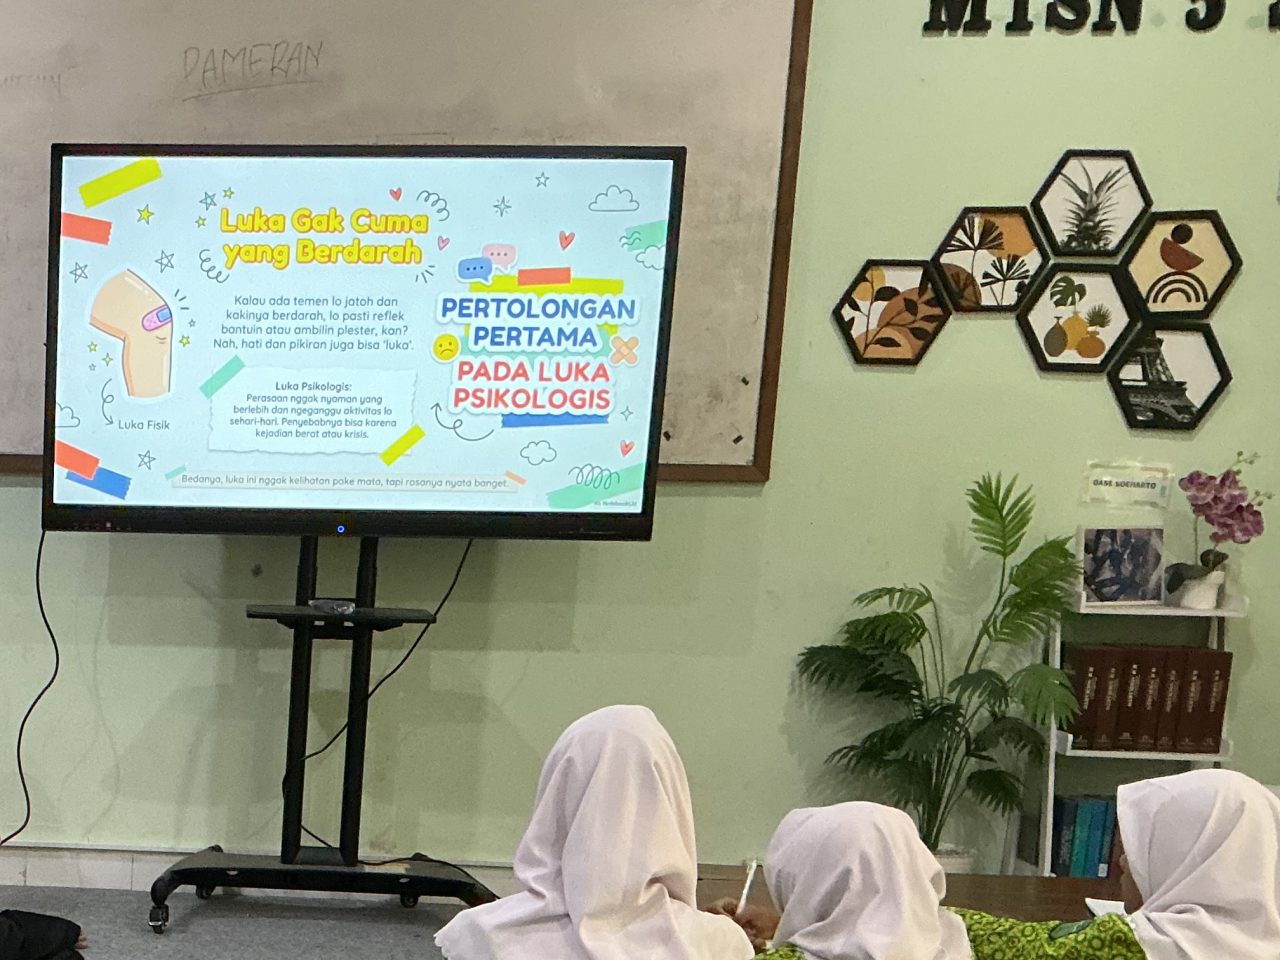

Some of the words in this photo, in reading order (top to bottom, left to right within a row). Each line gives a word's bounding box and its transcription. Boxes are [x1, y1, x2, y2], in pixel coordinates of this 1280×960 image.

[220, 207, 286, 233] Luka
[291, 207, 345, 233] Gak
[350, 208, 429, 233] Cuma
[223, 243, 290, 270] yang
[295, 238, 422, 264] Berdarah
[234, 296, 266, 306] Kalau
[269, 296, 290, 306] ada
[293, 297, 329, 306] temen
[332, 296, 342, 306] lo
[344, 296, 374, 309] jatoh
[377, 297, 398, 306] dan
[441, 298, 635, 319] PERTOLONGAN
[226, 310, 269, 323] kakinya
[272, 310, 326, 322] berdarah,
[329, 311, 340, 321] lo
[343, 311, 369, 323] pasti
[372, 311, 404, 321] reflek
[221, 324, 262, 335] bantuin
[265, 326, 290, 335] atau
[294, 325, 334, 335] ambilin
[338, 325, 378, 337] plester,
[382, 326, 408, 336] kan?
[473, 327, 597, 347] PERTAMA
[214, 339, 238, 350] Nah,
[242, 339, 262, 349] hati
[266, 339, 286, 349] dan
[290, 339, 326, 351] pikiran
[330, 340, 354, 352] juga
[358, 340, 380, 350] bisa
[458, 361, 530, 382] PADA
[538, 362, 610, 383] LUKA
[276, 382, 299, 391] Luka
[302, 382, 352, 393] Psikologis:
[246, 394, 288, 403] Perasaan
[290, 394, 319, 406] nggak
[320, 396, 358, 406] nyaman
[360, 396, 382, 406] yang
[453, 388, 611, 410] PSIKOLOGIS
[233, 406, 269, 414] berlebih
[272, 406, 288, 414] dan
[291, 407, 341, 417] ngeganggu
[344, 406, 382, 416] aktivitas
[384, 406, 392, 415] lo
[118, 420, 144, 430] Luka
[147, 420, 170, 430] Fisik
[230, 417, 279, 426] sehari-hari.
[282, 417, 342, 429] Penyebabnya
[344, 418, 363, 427] bisa
[366, 418, 397, 427] karena
[256, 429, 293, 440] kejadian
[296, 430, 319, 438] berat
[322, 430, 342, 439] atau
[344, 430, 369, 439] krisis.
[182, 475, 223, 485] Bedanya,
[226, 476, 244, 484] luka
[246, 476, 256, 484] ini
[259, 476, 286, 486] nggak
[290, 476, 330, 485] kelihatan
[358, 478, 384, 487] mata,
[386, 478, 403, 488] tapi
[406, 480, 442, 488] rasanya
[446, 479, 472, 489] nyata
[474, 479, 510, 490] banget.
